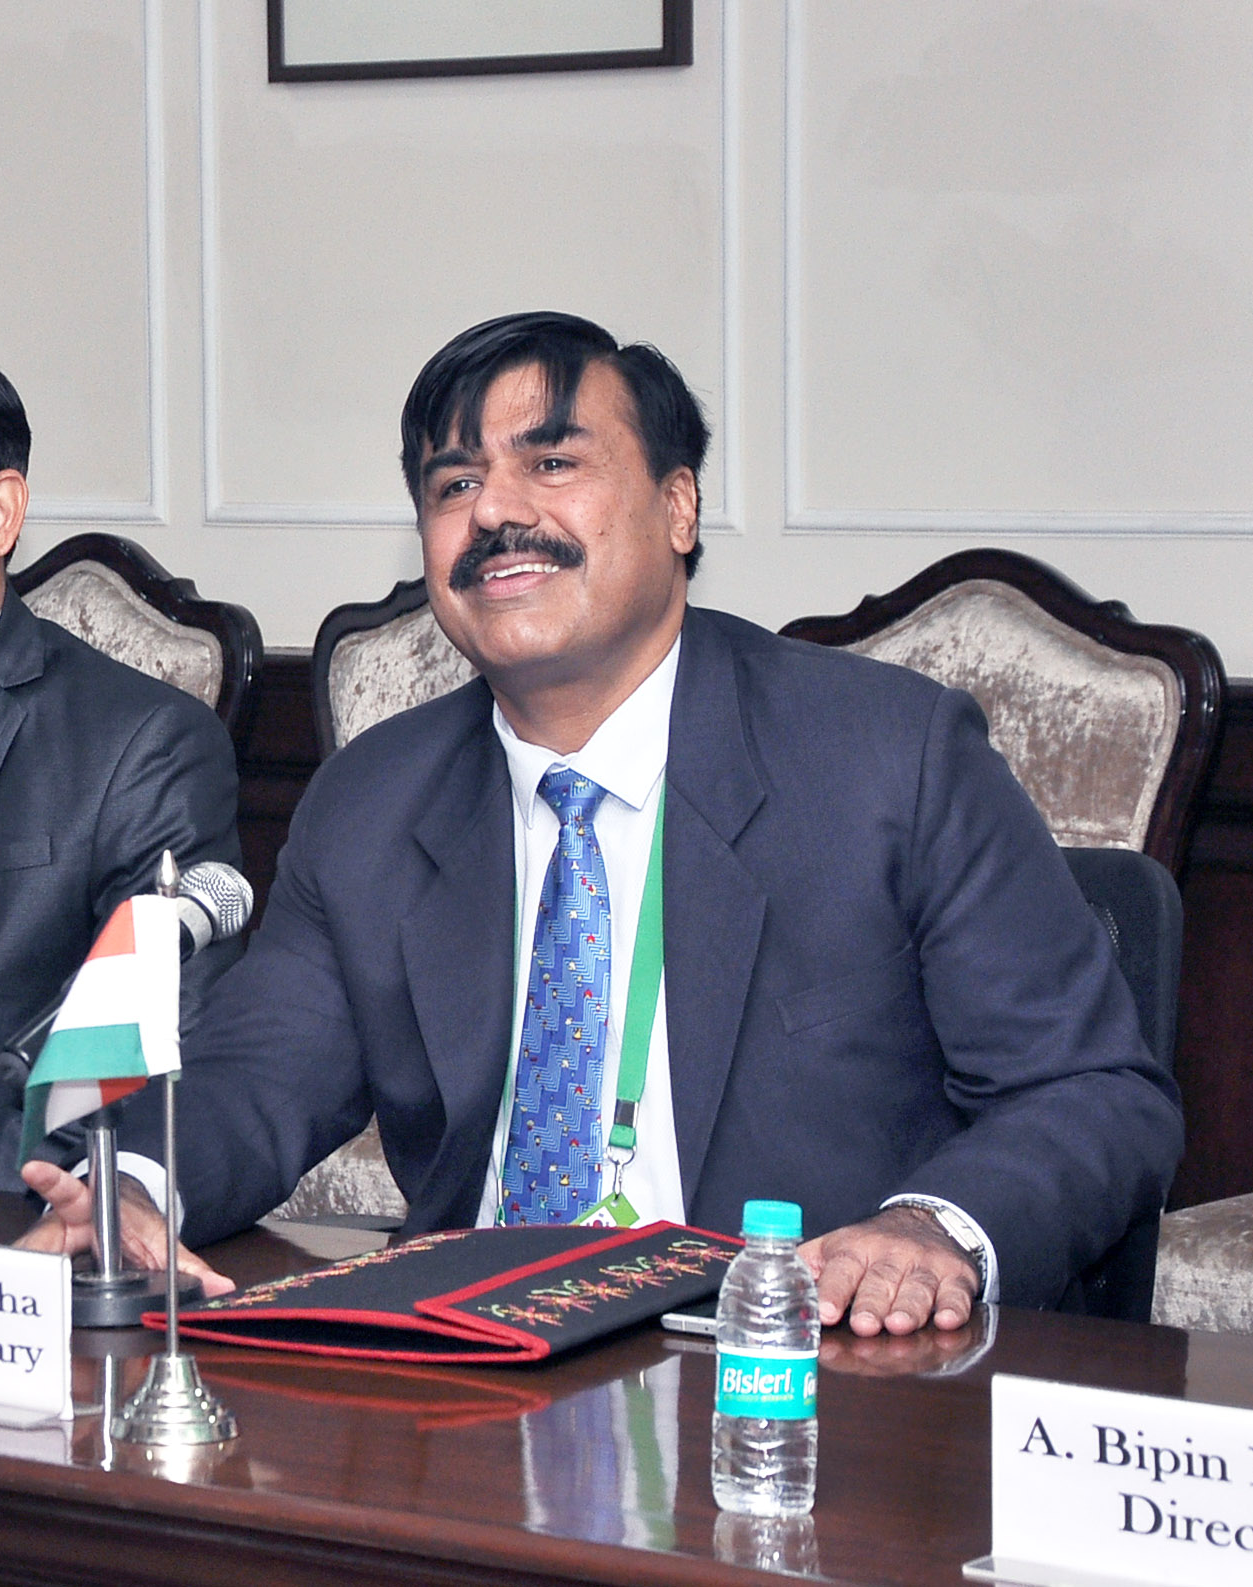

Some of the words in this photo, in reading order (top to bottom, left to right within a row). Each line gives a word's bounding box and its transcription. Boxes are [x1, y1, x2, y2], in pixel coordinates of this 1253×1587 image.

[723, 1366, 792, 1394] Bisleri
[1019, 1416, 1074, 1460] A.
[1092, 1424, 1231, 1483] Bipin
[1118, 1491, 1253, 1552] Direc
